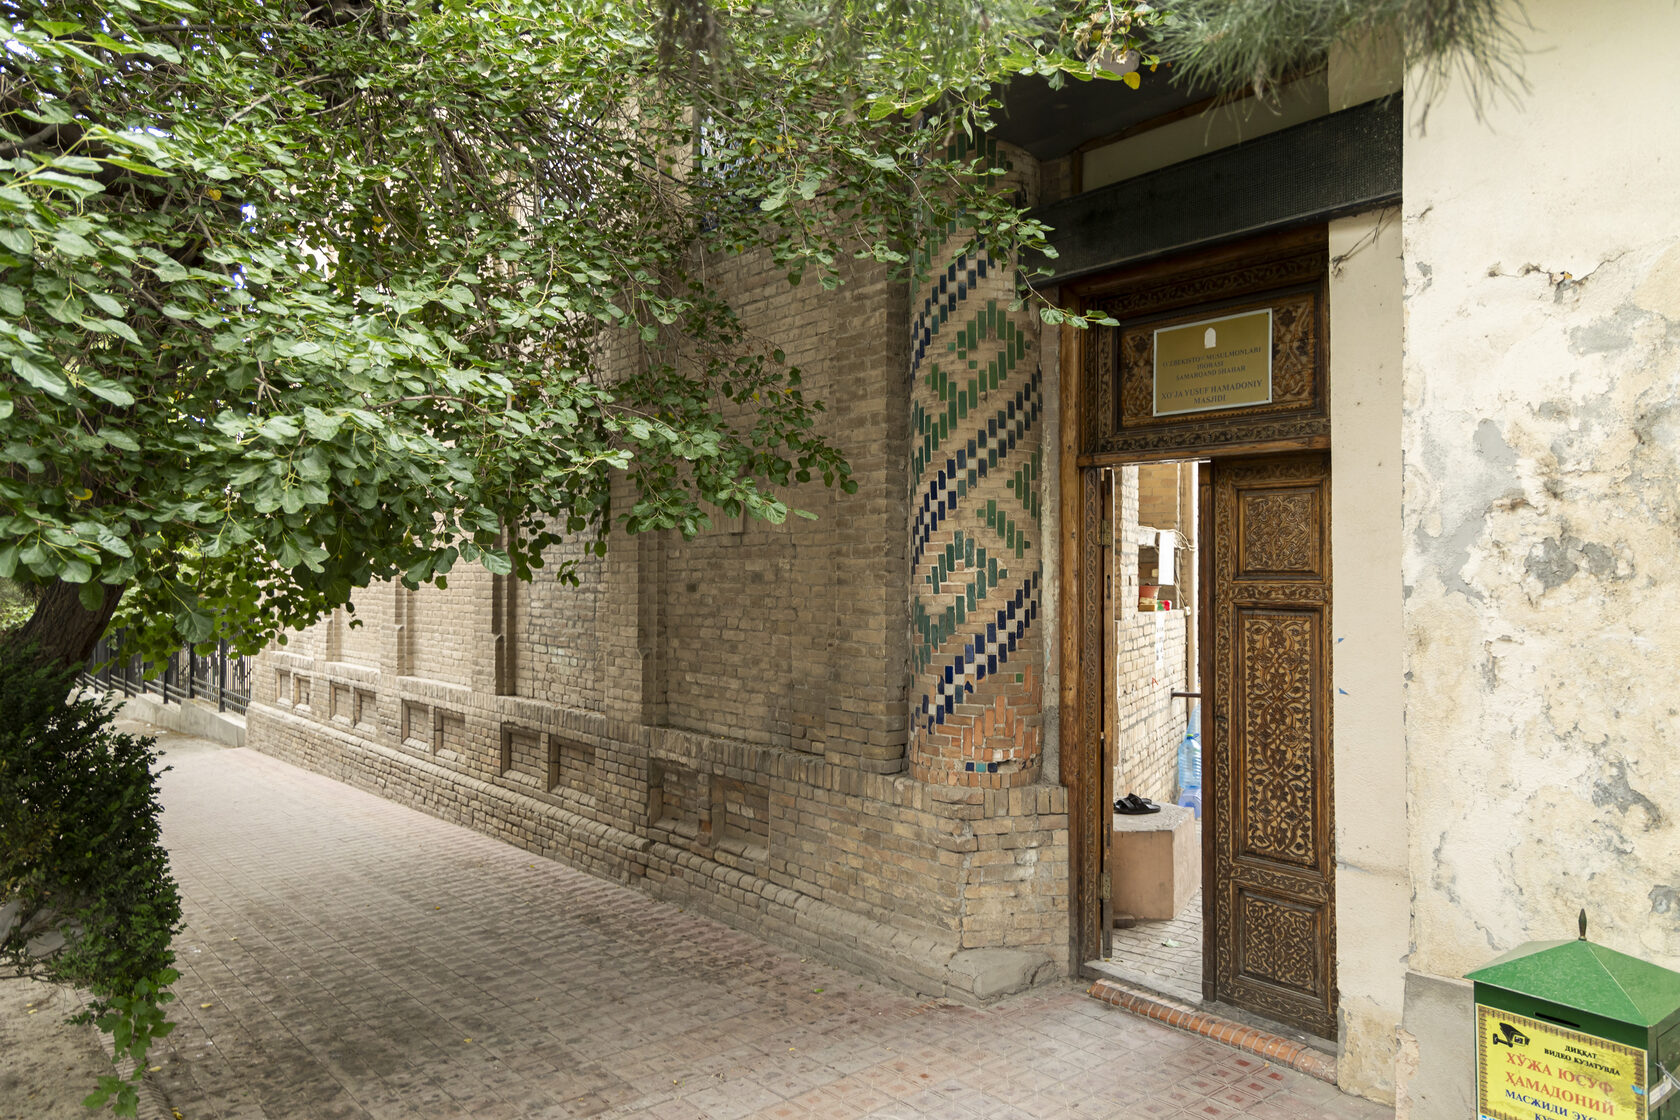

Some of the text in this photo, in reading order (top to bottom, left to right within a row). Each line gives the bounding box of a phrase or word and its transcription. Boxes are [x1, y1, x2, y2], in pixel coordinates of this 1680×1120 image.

[1184, 387, 1209, 397] YUSUF
[1211, 379, 1263, 393] HAMADONIY
[1194, 394, 1226, 404] MASJIDI
[1506, 1052, 1614, 1096] ХЎЖА ЮСУФ
[1544, 1048, 1621, 1076] ВИДЕО КУЗАТУВДА
[1505, 1088, 1567, 1117] МАСЖИДИ
